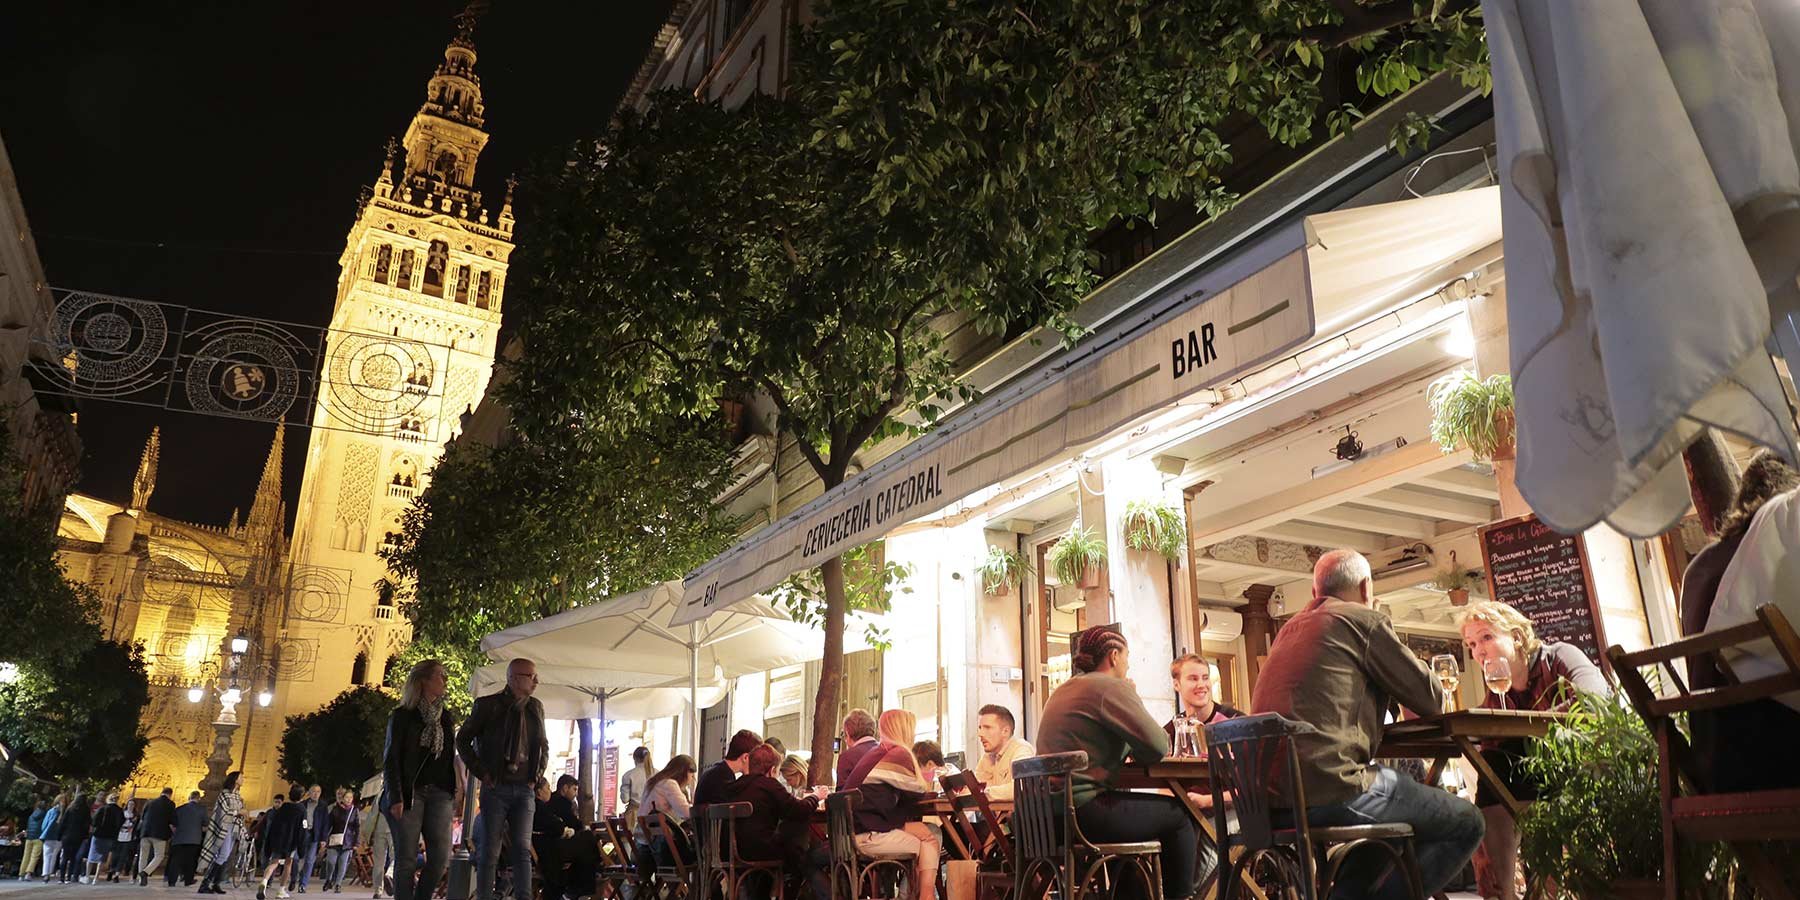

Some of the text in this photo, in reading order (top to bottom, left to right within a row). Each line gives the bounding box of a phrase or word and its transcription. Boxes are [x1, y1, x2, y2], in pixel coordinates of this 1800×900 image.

[1172, 322, 1217, 379] BAR
[803, 463, 942, 557] CERVECERÍA CATEDRAL
